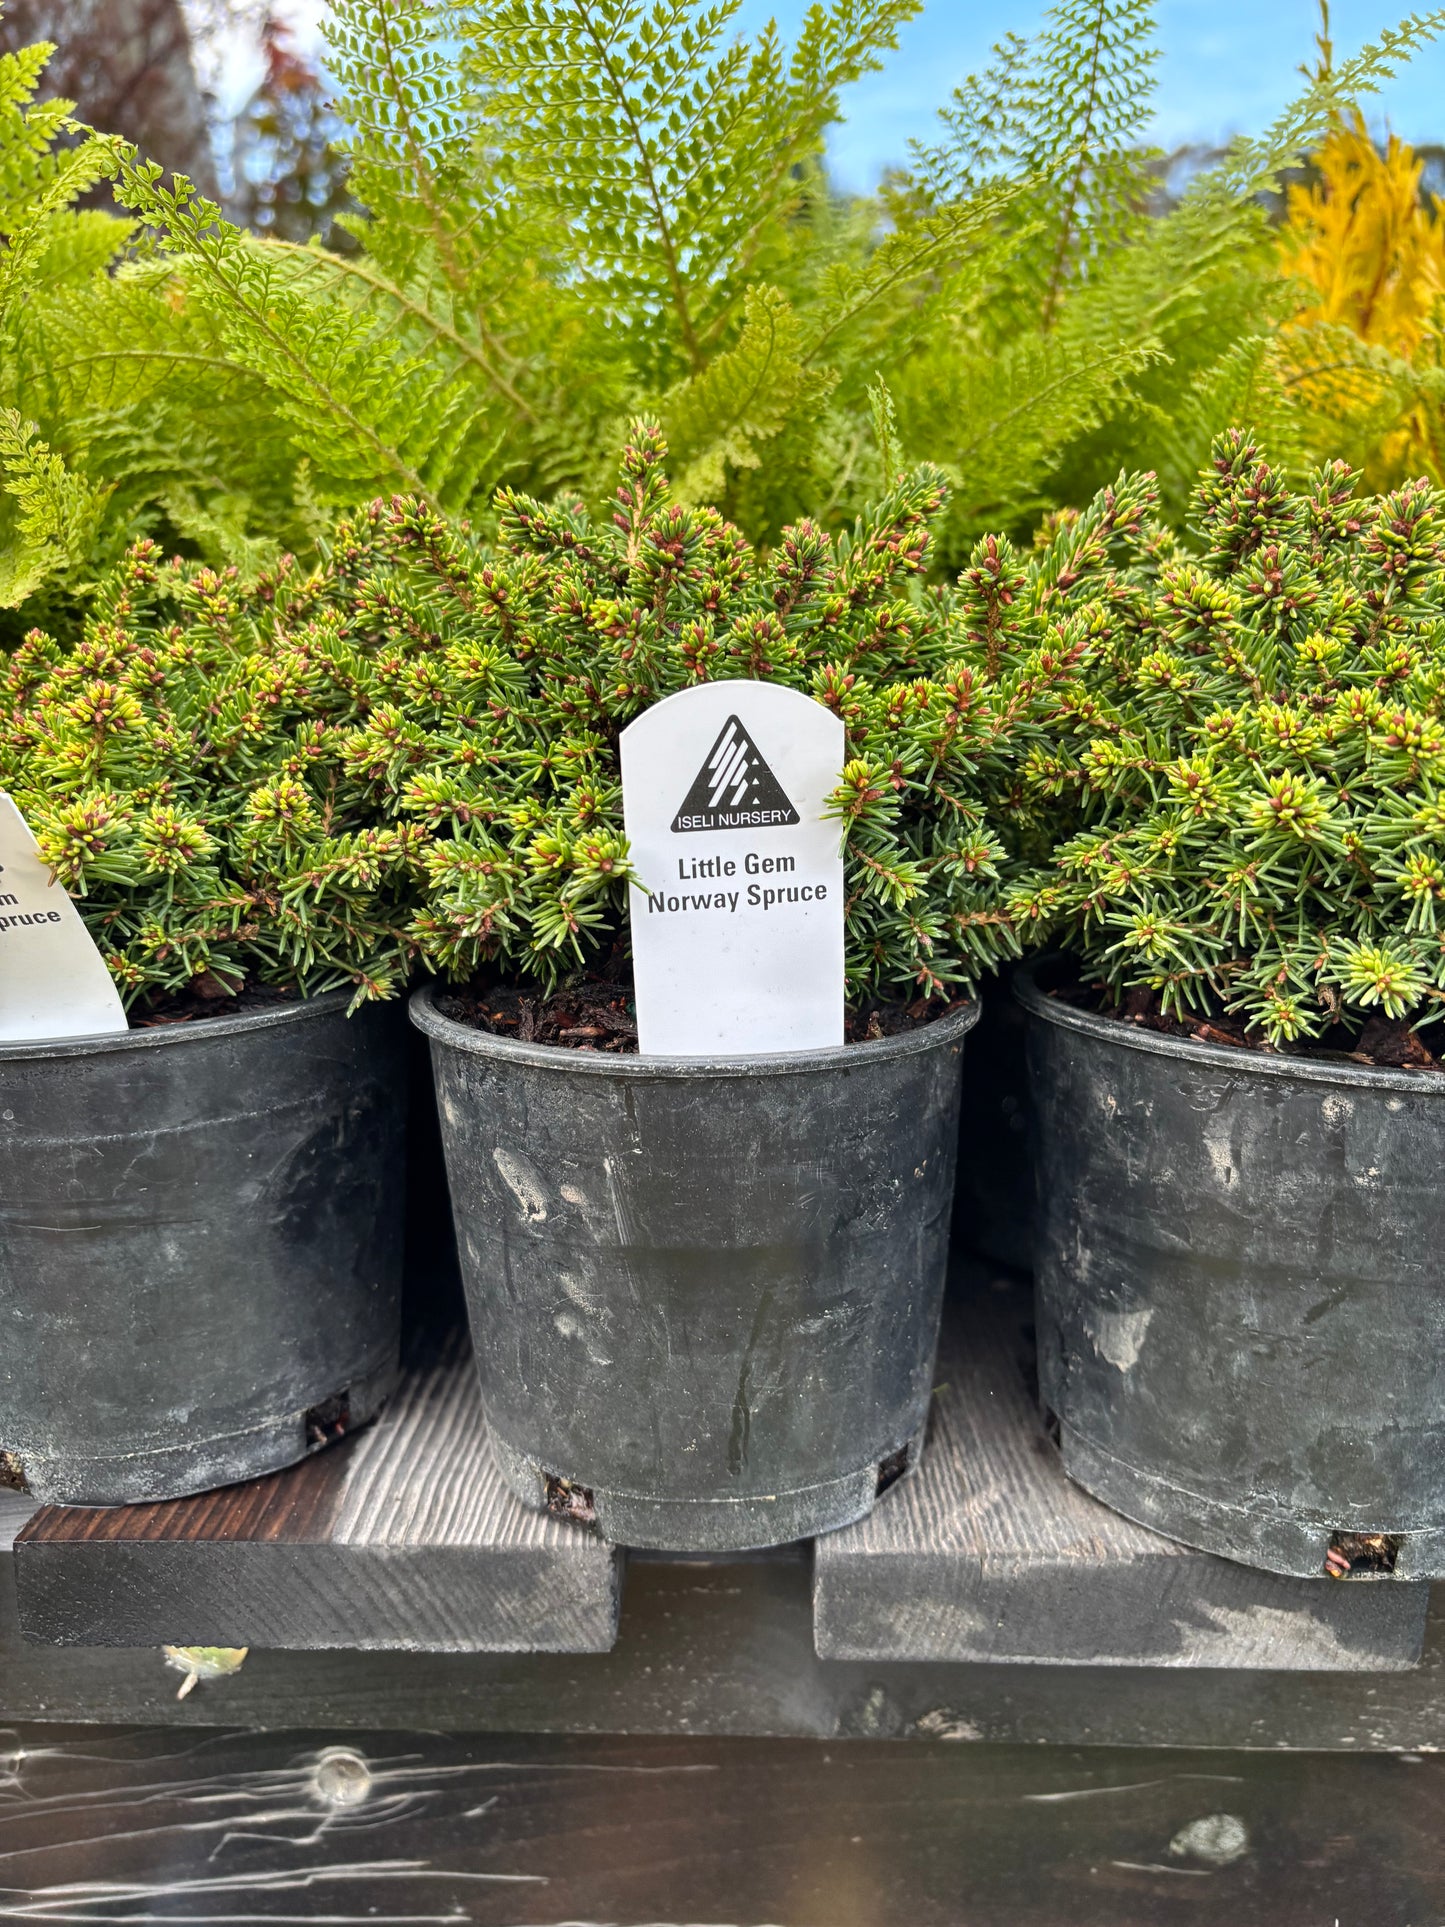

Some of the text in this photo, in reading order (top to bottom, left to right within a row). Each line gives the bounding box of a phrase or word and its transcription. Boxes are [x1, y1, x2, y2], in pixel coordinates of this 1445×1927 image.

[678, 809, 792, 829] ISELI NURSERY
[679, 853, 795, 879] Little Gem
[649, 884, 827, 913] Norway Spruce
[0, 911, 61, 932] pruce
